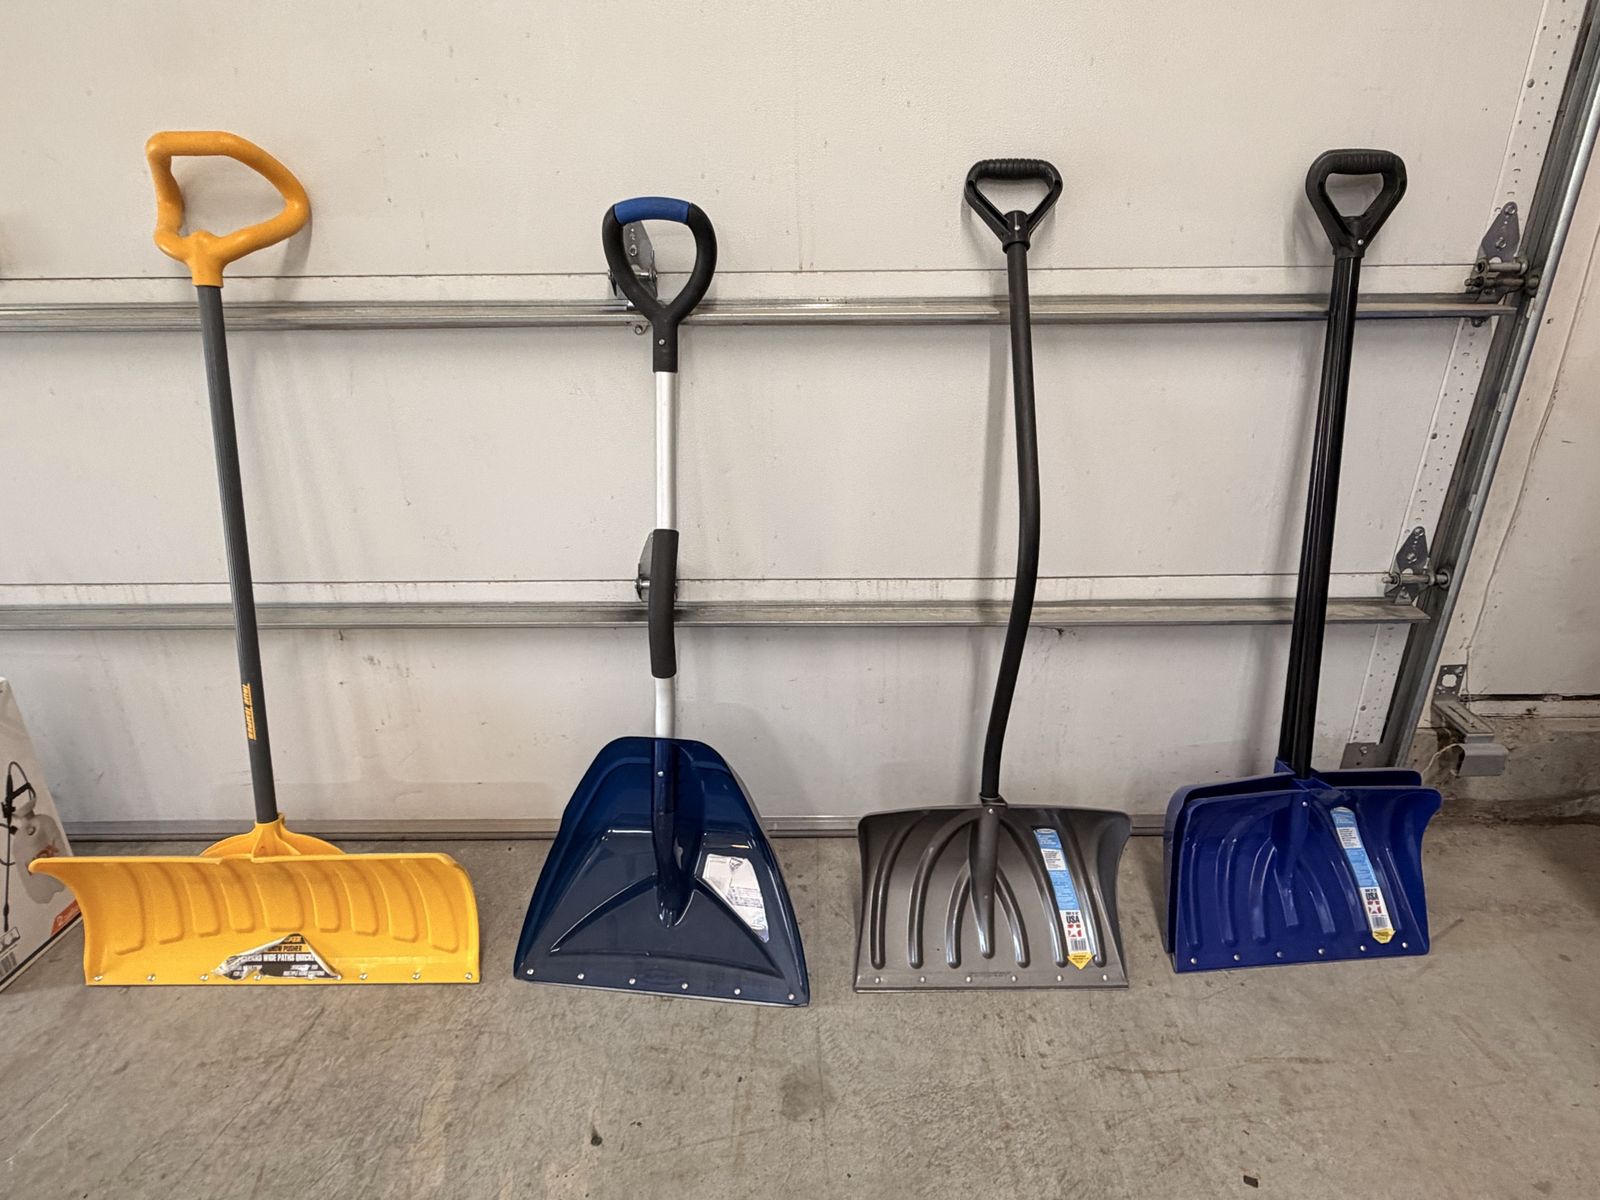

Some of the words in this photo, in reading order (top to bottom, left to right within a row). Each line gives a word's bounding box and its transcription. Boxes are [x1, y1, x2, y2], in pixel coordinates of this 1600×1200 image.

[1366, 892, 1380, 901] USA
[1066, 915, 1081, 924] USA
[263, 953, 277, 962] WIDE
[277, 953, 295, 962] PATHS
